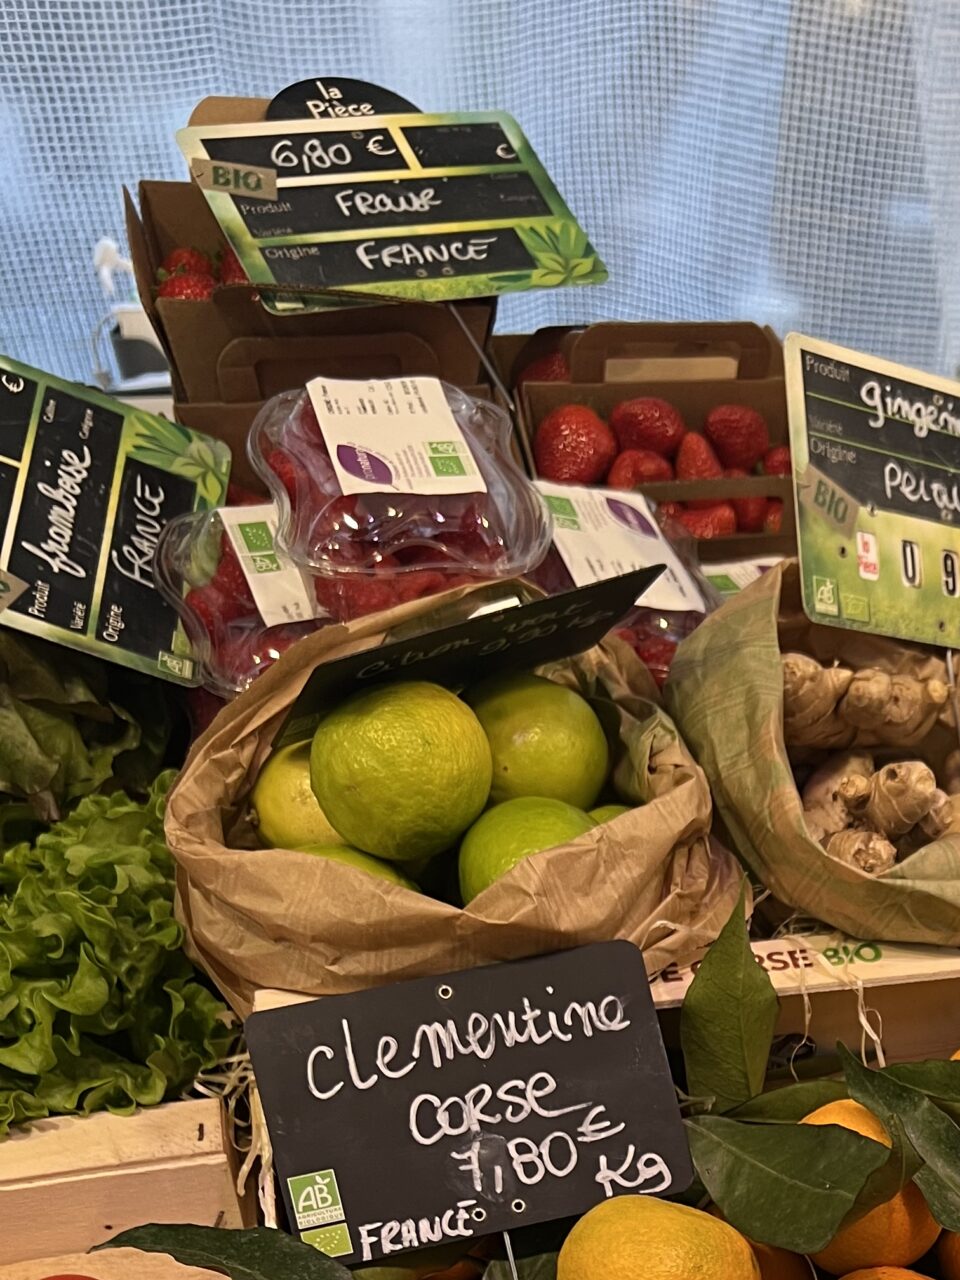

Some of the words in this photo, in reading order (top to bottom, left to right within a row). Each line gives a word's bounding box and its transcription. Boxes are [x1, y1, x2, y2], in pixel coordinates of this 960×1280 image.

[315, 80, 343, 100] la
[306, 100, 375, 119] Pièce
[271, 138, 352, 174] 6,80
[366, 135, 397, 156] €
[212, 165, 263, 192] BIO
[265, 246, 320, 260] Origine
[356, 237, 498, 270] FRANCE
[810, 437, 857, 464] Origine
[813, 479, 850, 525] BIO
[111, 473, 166, 589] FRANCE
[28, 579, 50, 619] Produit
[102, 604, 125, 643] Origine
[822, 942, 882, 967] BIO
[299, 1184, 333, 1212] AB
[358, 1200, 478, 1262] FRANCE
